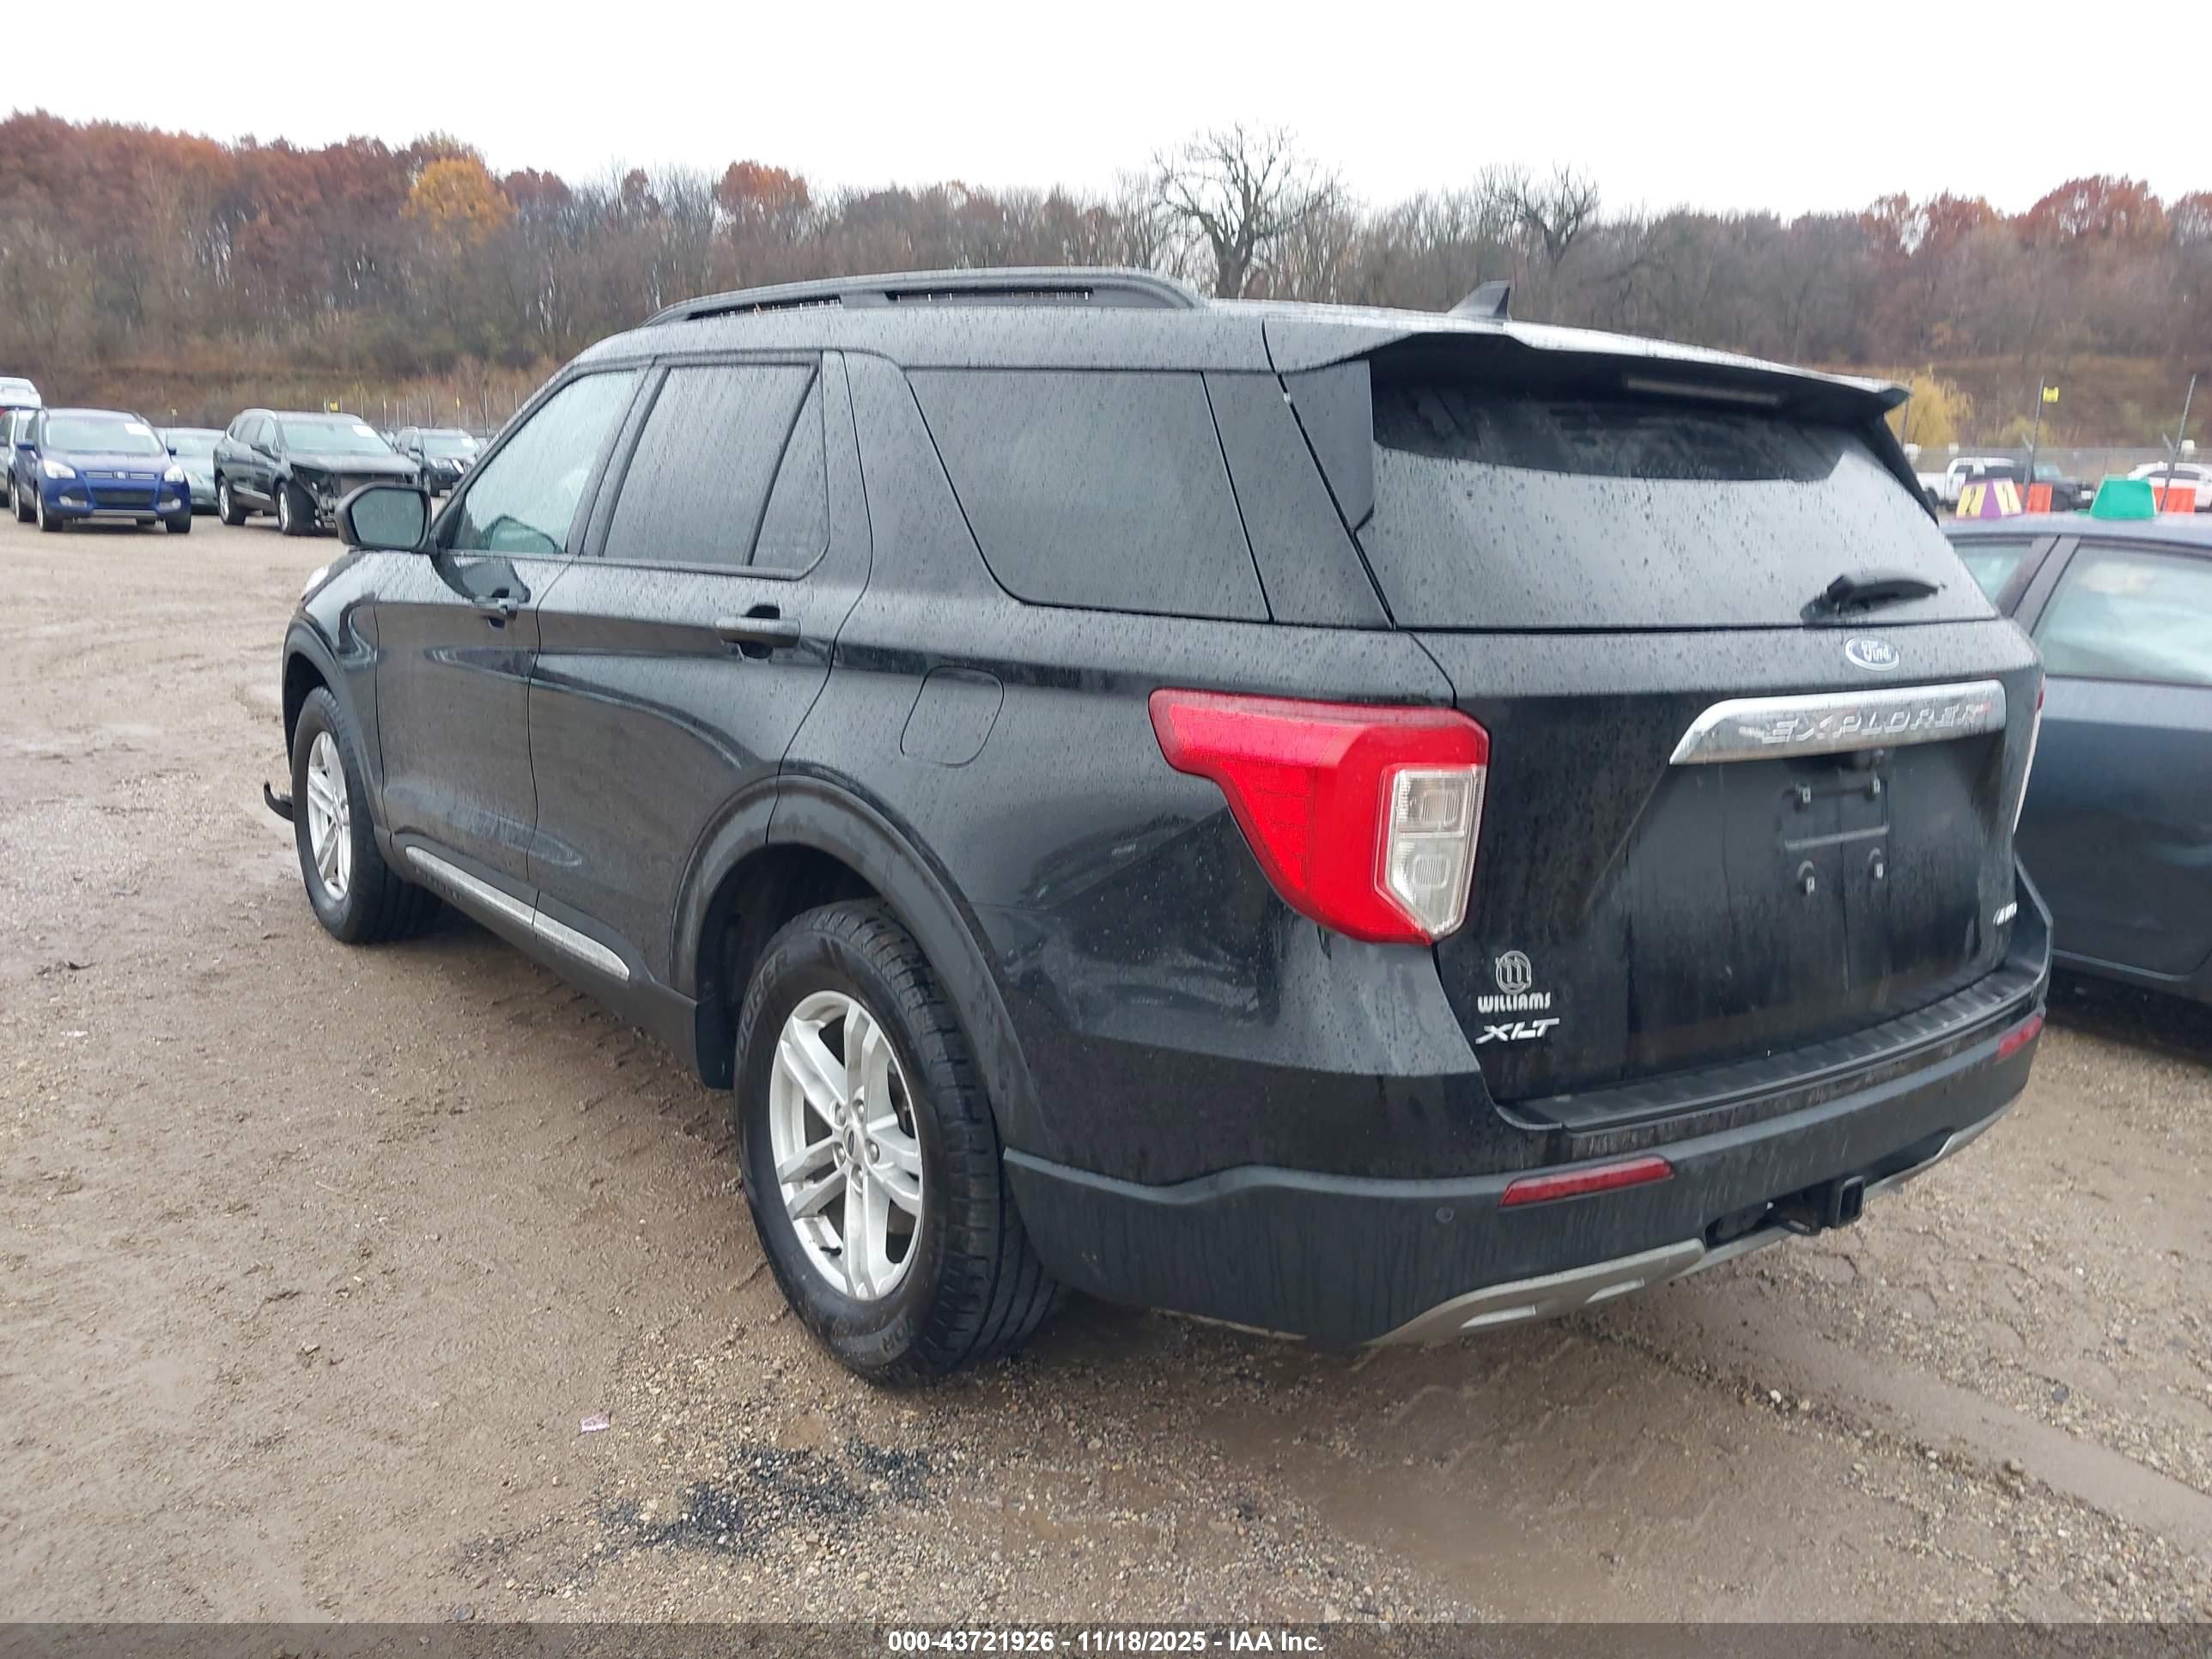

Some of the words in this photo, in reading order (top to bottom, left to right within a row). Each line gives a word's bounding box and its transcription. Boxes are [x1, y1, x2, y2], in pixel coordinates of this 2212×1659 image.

[1759, 701, 1987, 744] EXPLORER
[1477, 992, 1551, 1014] WILLIAMS
[1475, 1018, 1560, 1044] XLT
